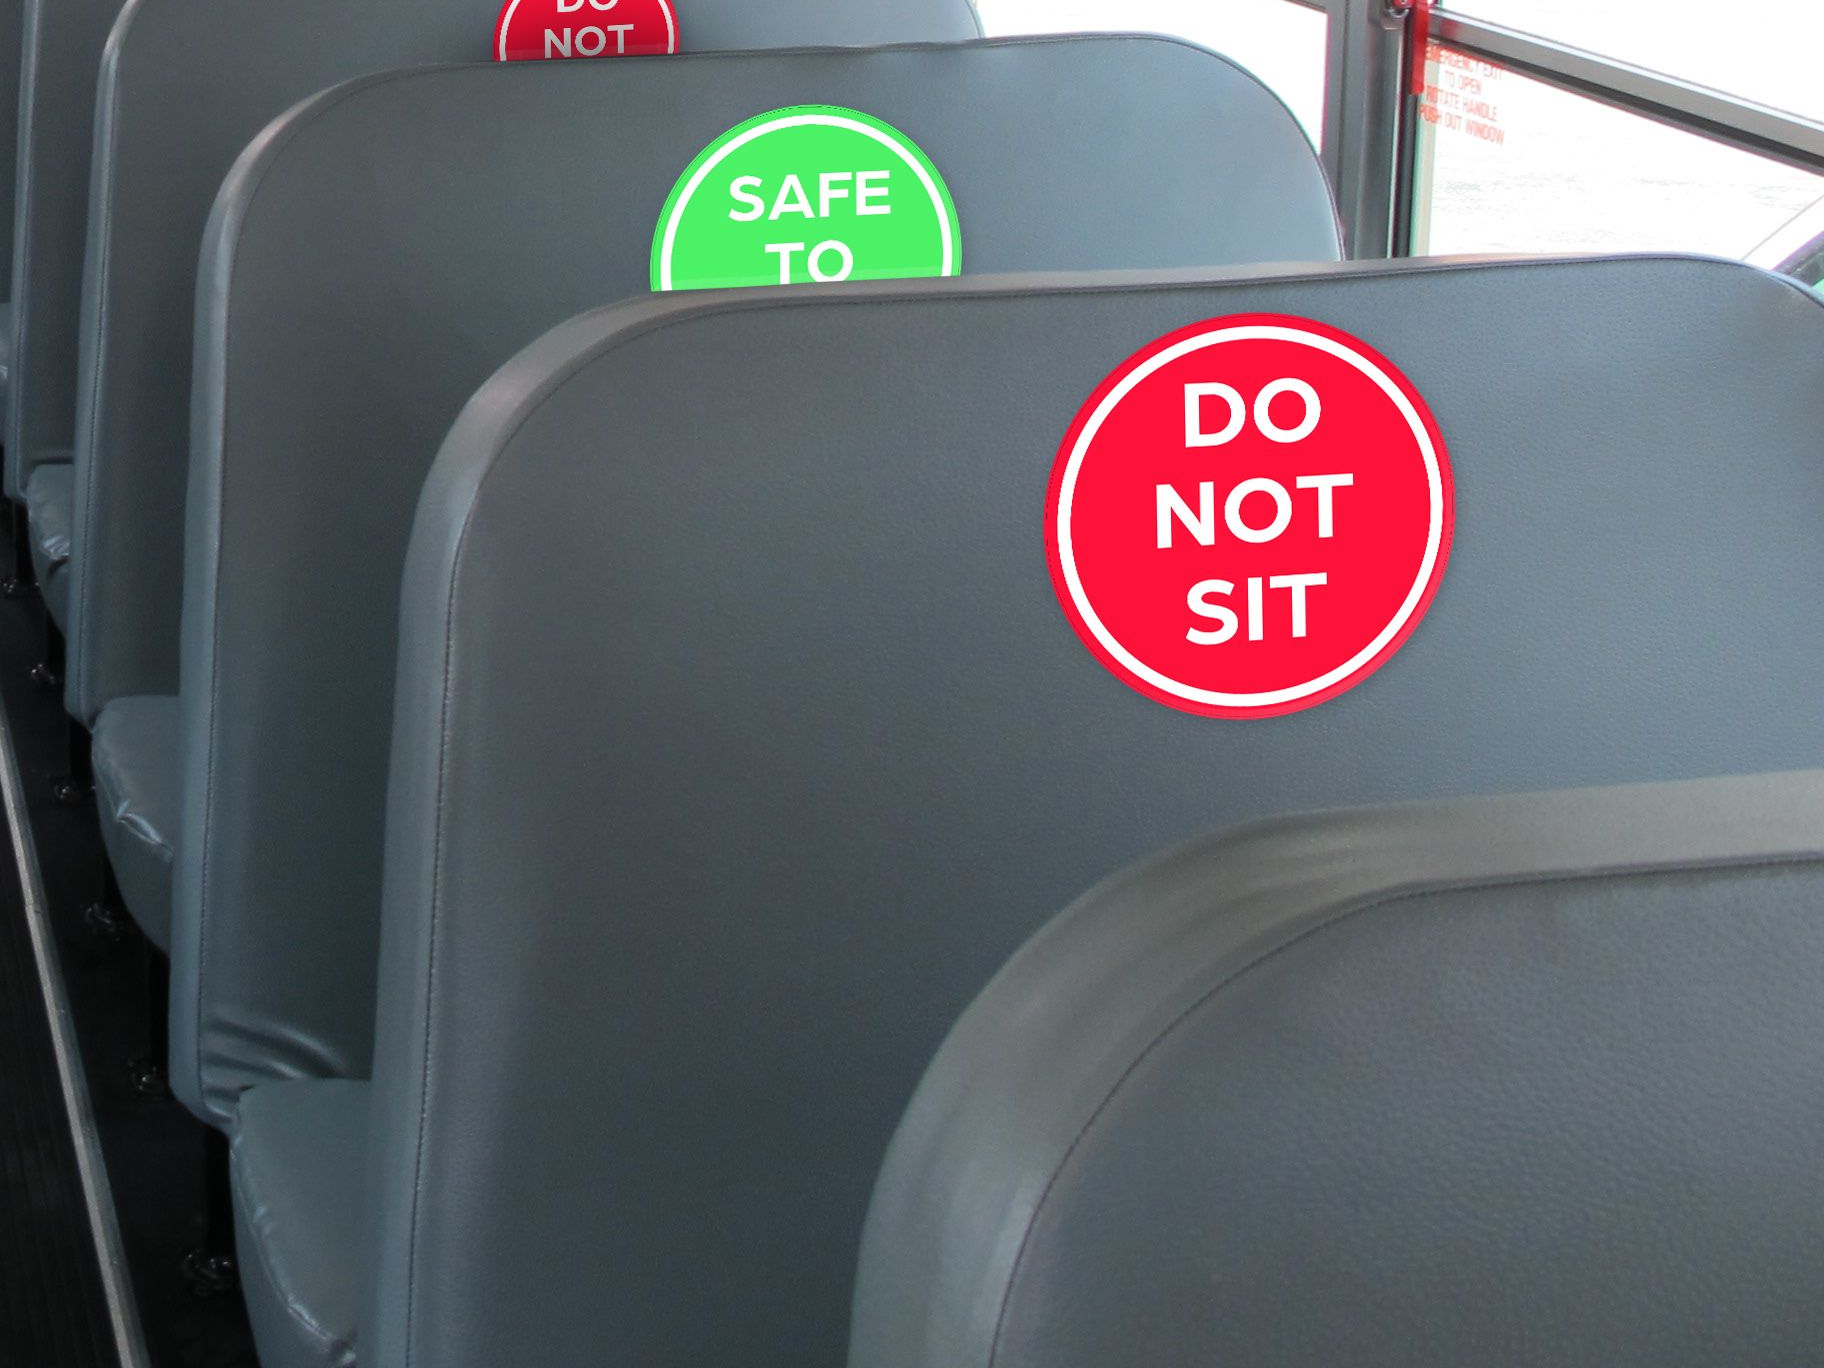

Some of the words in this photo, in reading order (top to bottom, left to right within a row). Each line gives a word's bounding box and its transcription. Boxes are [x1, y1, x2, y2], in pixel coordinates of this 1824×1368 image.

[544, 23, 635, 59] NOT
[727, 170, 892, 223] SAFE
[764, 239, 854, 284] TO
[1183, 377, 1322, 449] DO
[1155, 472, 1354, 550] NOT
[1184, 572, 1329, 646] SIT
